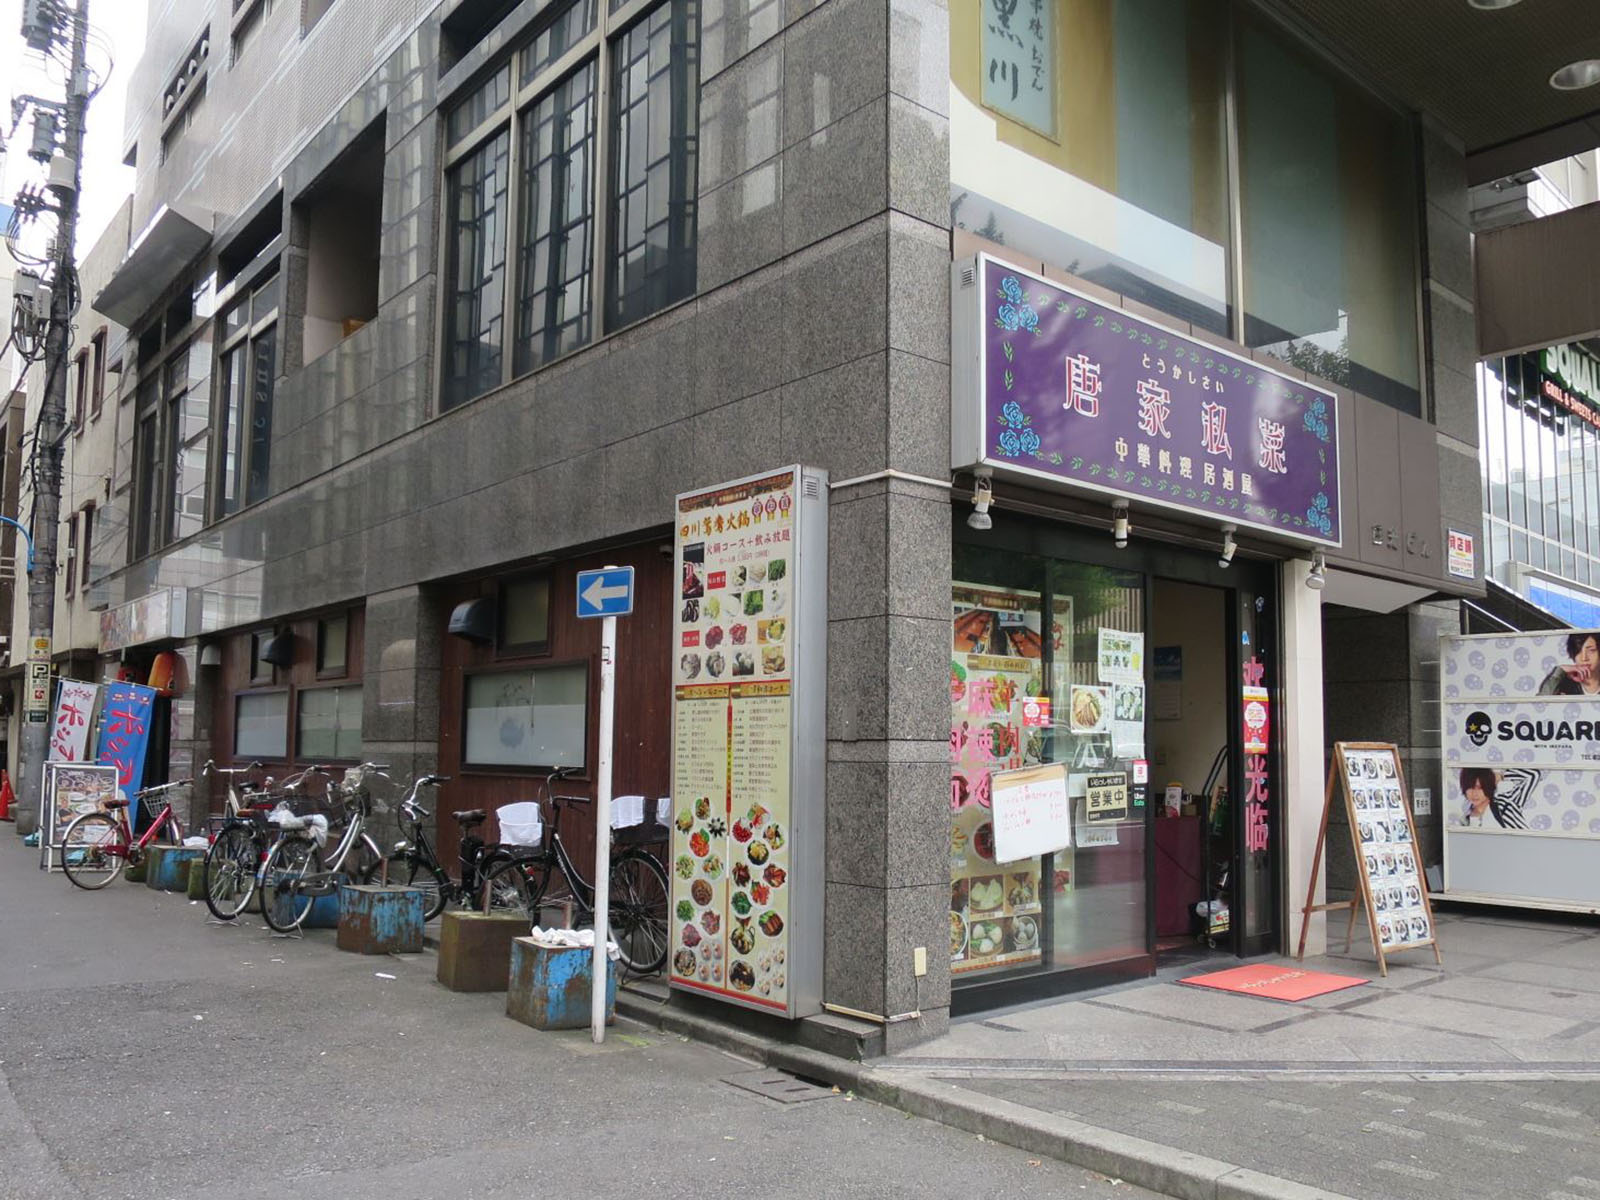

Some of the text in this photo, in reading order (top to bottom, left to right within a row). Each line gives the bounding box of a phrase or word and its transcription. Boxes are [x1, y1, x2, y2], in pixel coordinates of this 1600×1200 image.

[1142, 353, 1225, 393] とうかしさい
[1063, 354, 1287, 473] 唐家私菜
[1114, 437, 1253, 497] 中華料理居酒屋
[1449, 535, 1472, 554] 貸店舗
[34, 665, 47, 677] P
[1090, 789, 1124, 808] 営業中
